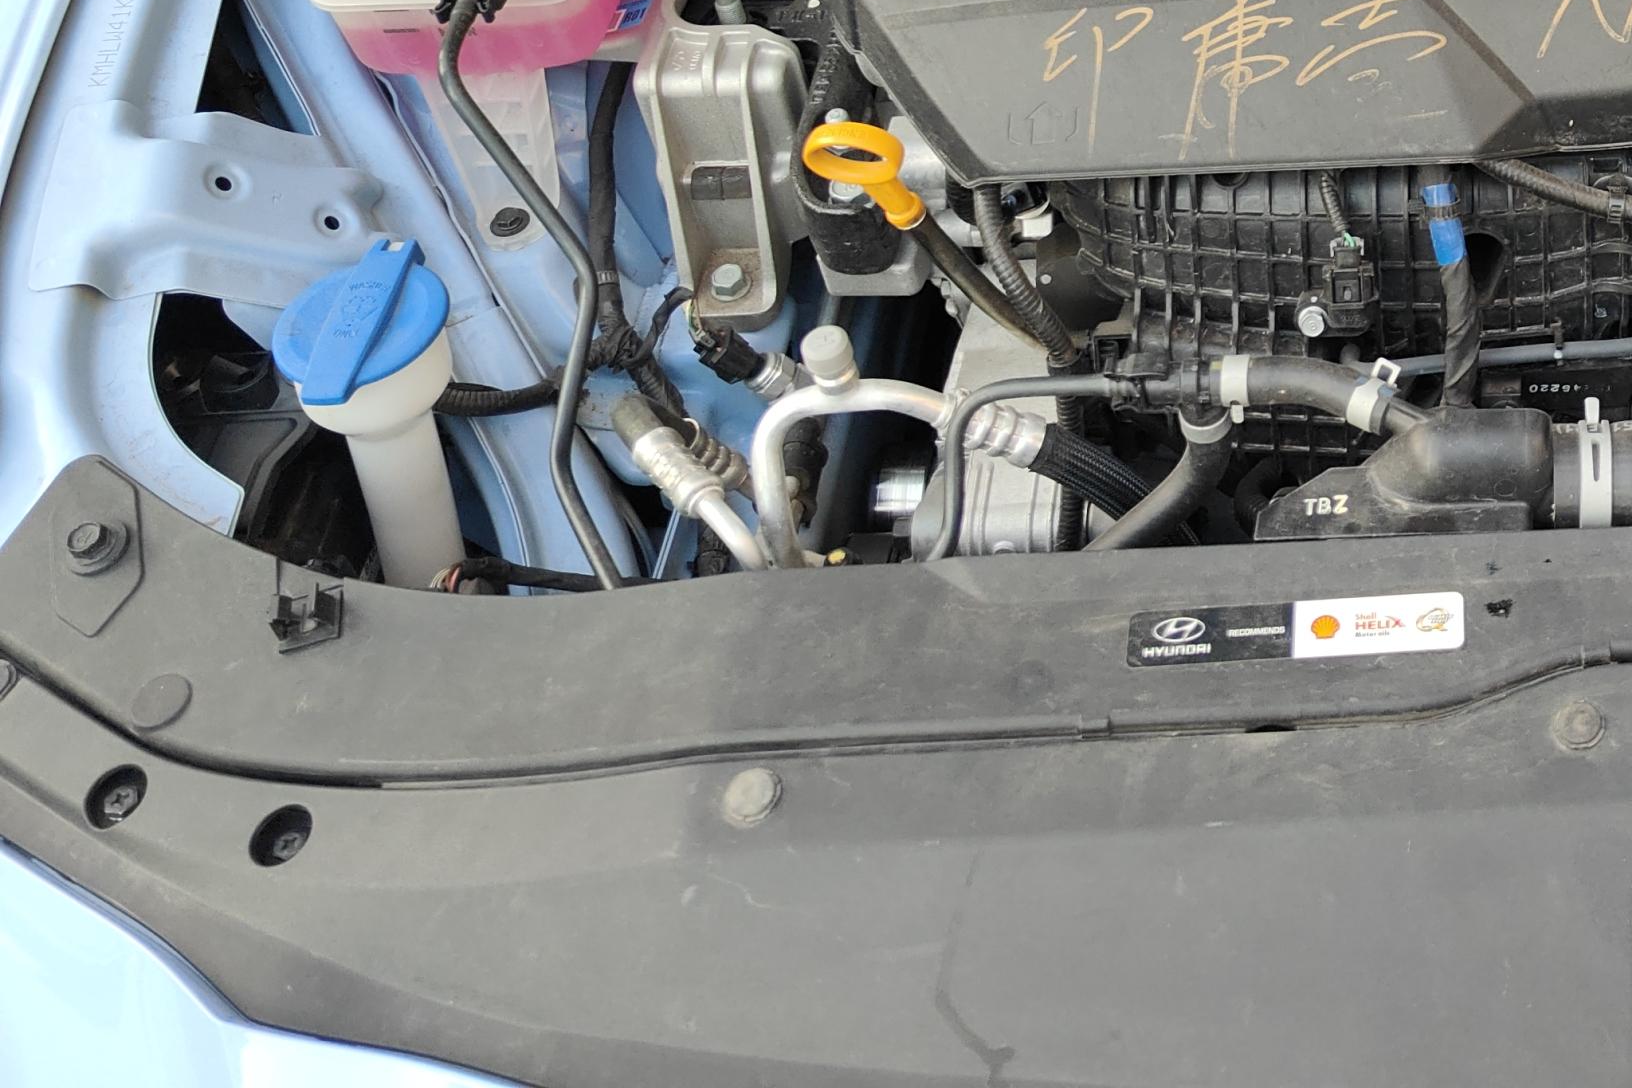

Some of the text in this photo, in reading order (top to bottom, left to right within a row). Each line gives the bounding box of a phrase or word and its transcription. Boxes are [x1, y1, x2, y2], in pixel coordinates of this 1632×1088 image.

[1355, 616, 1406, 630] HELIX
[1226, 626, 1286, 637] RECOMMENDS
[1142, 643, 1212, 658] HYUNDAI
